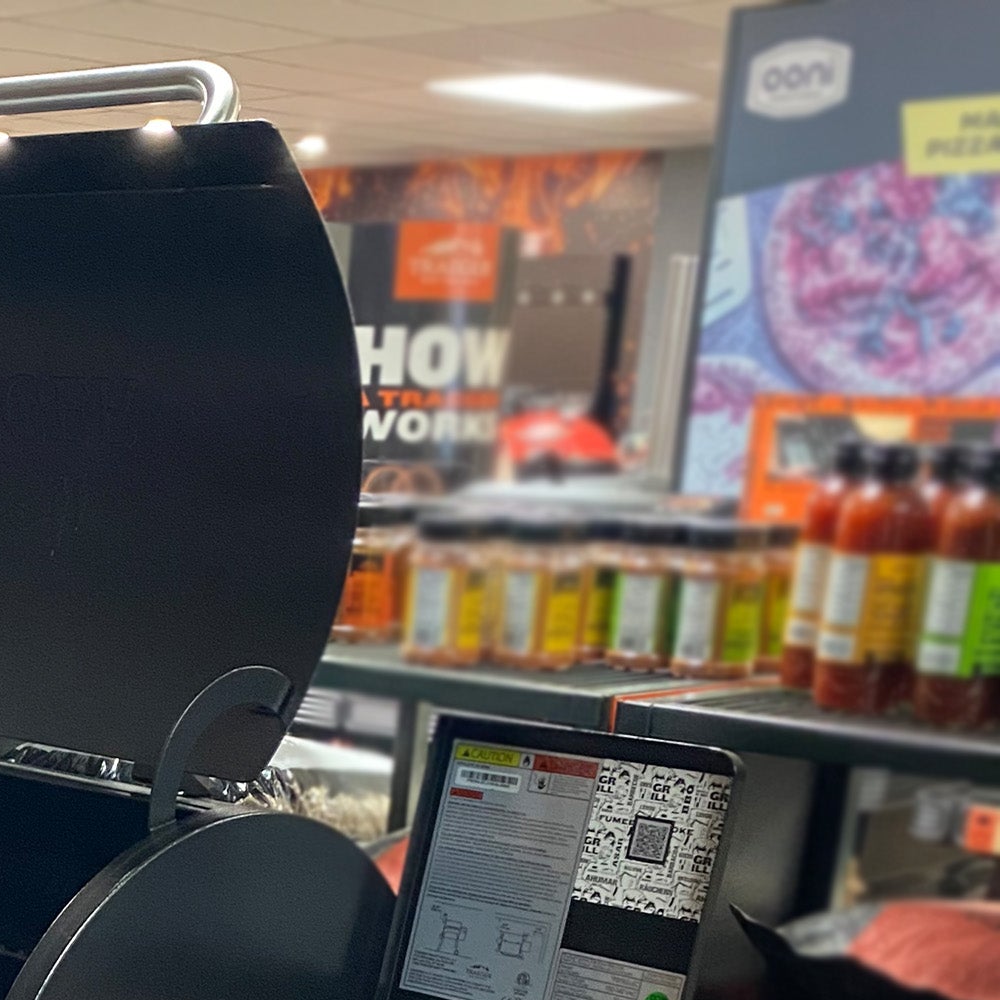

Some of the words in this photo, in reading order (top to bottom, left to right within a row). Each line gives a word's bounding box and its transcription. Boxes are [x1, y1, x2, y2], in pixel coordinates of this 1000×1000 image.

[762, 57, 835, 91] ooni
[354, 324, 512, 388] HOW
[470, 749, 514, 763] CAUTION
[585, 874, 618, 885] AHUMAR
